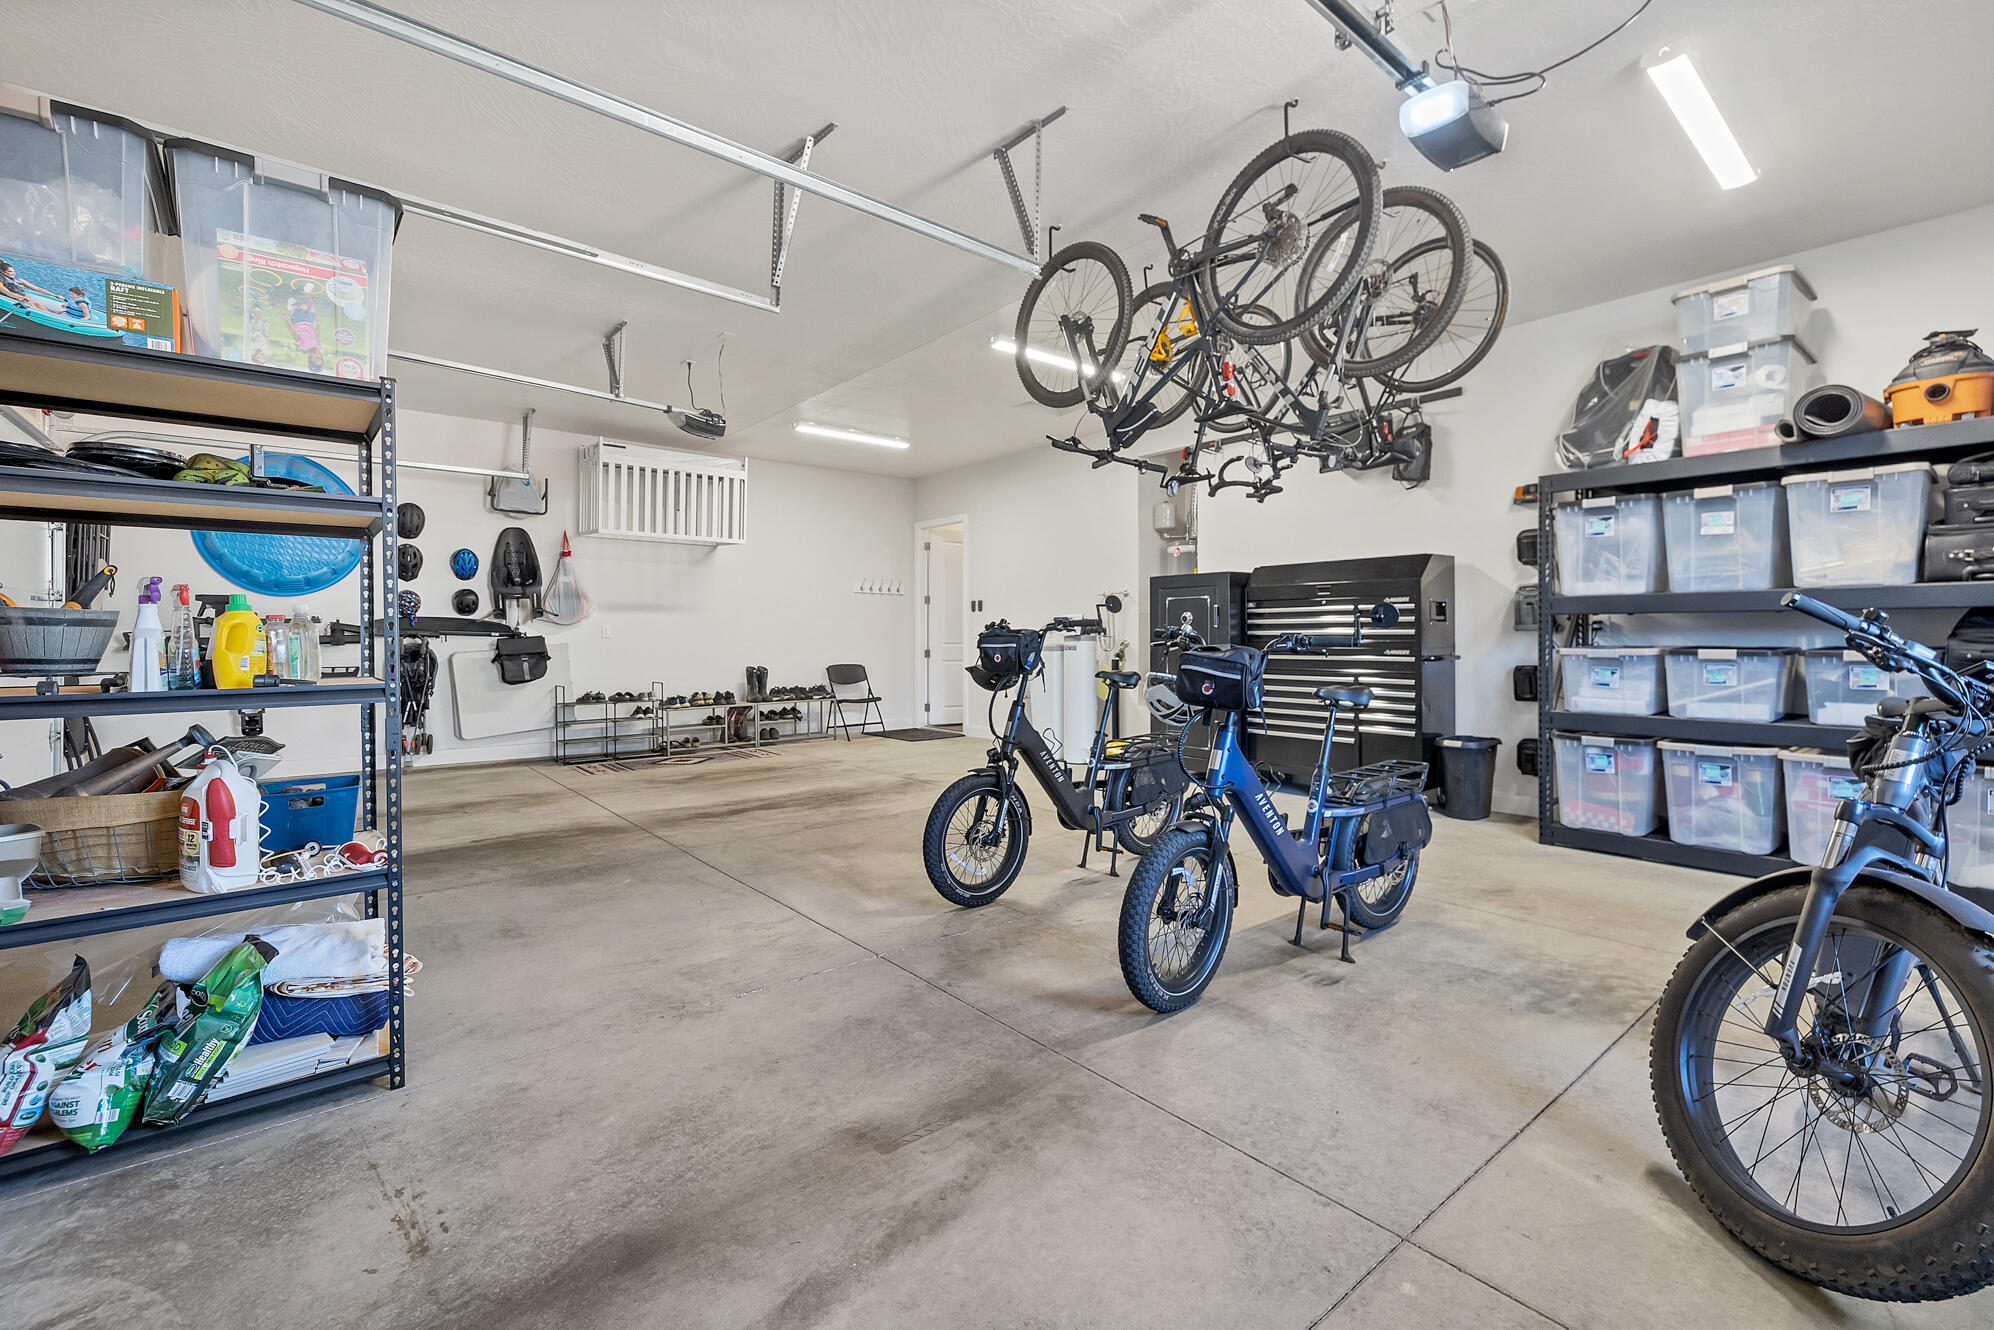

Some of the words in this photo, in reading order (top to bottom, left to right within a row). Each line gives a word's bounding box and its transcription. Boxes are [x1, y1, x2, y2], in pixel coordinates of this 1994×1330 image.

[110, 286, 129, 294] RAFT
[1039, 750, 1065, 783] AVENTON
[1254, 793, 1285, 836] AVENTON
[187, 833, 195, 843] 12
[193, 1037, 220, 1066] Healthy
